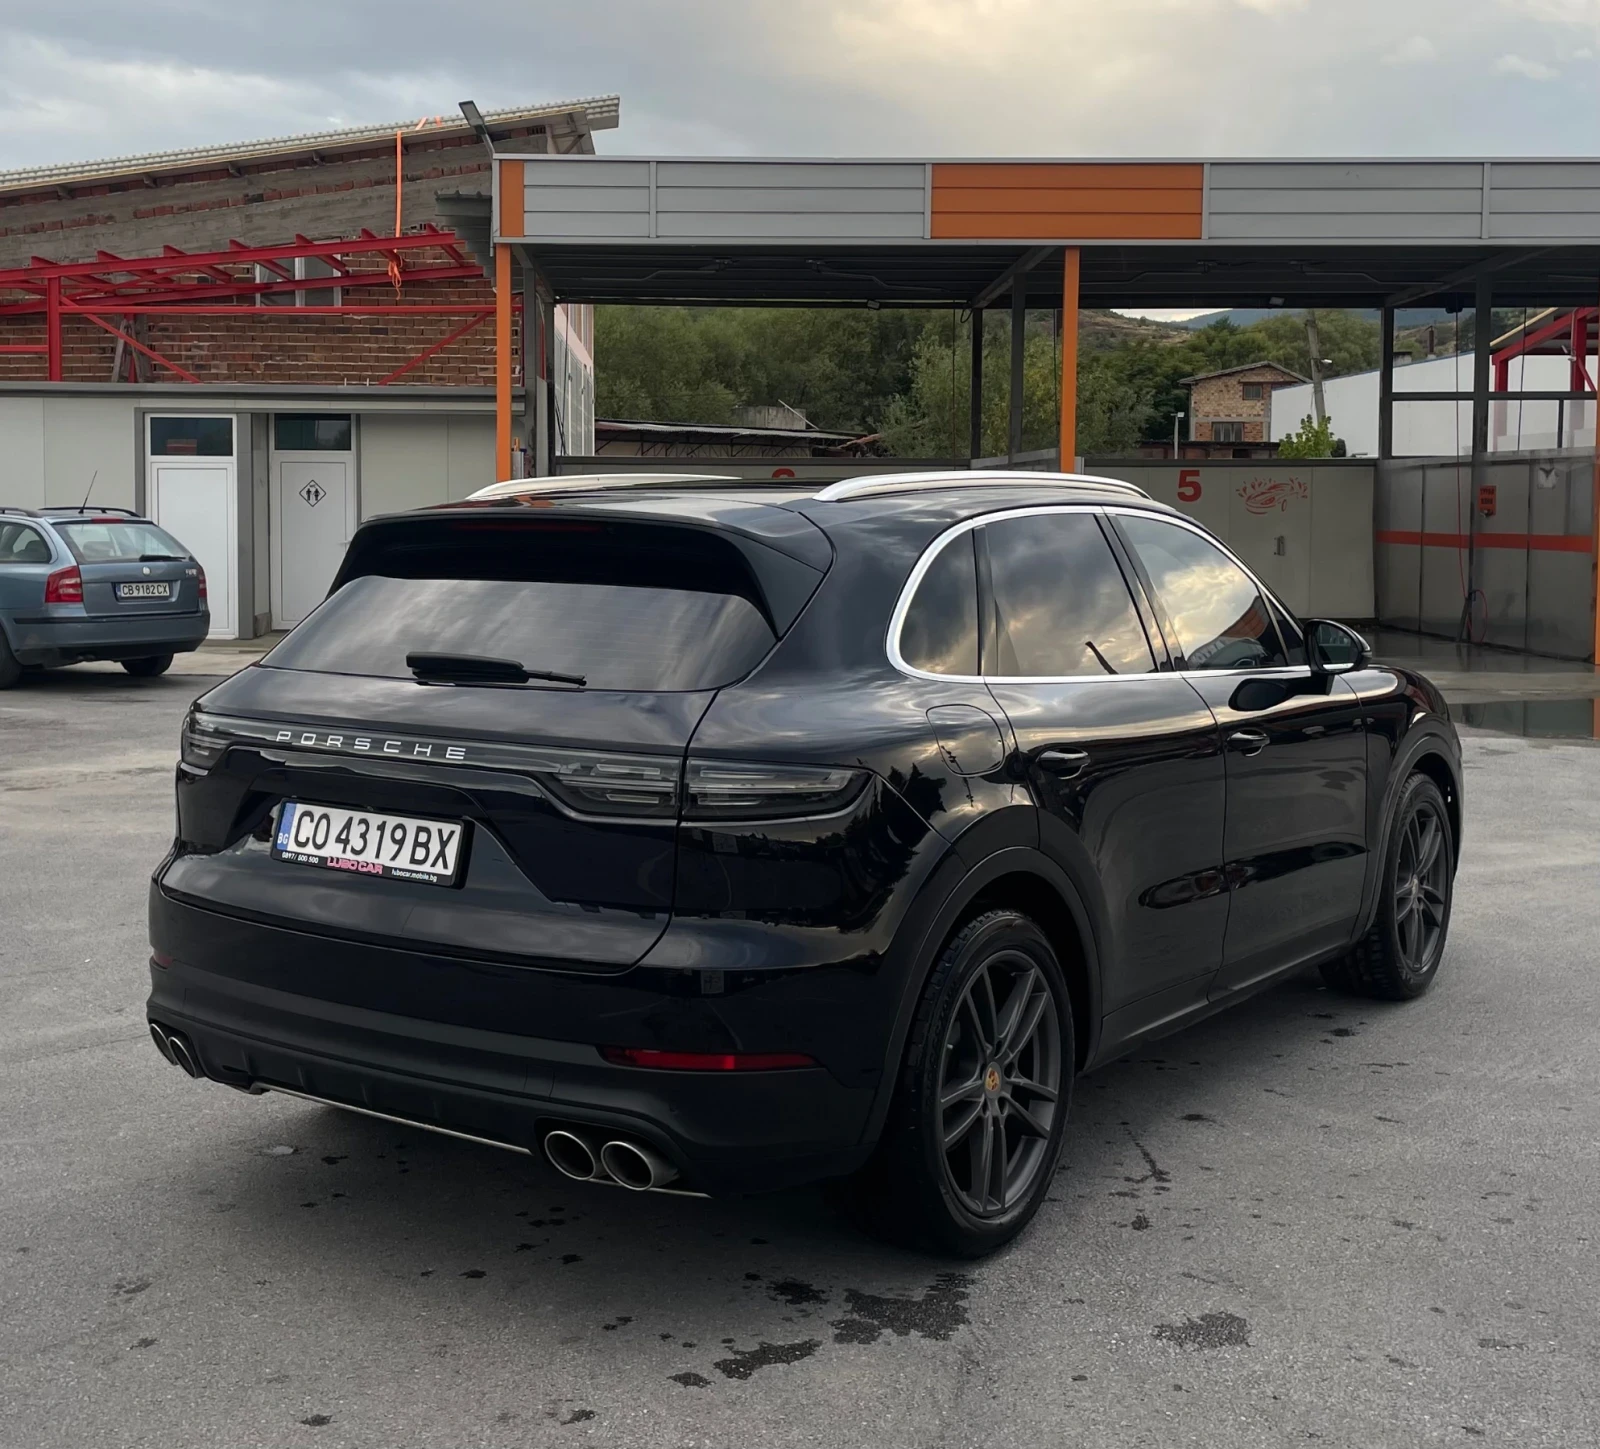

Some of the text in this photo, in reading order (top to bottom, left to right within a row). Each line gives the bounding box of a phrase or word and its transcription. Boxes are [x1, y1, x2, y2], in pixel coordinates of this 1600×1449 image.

[1177, 469, 1202, 502] 5
[122, 584, 168, 596] CB 9182 CX
[276, 730, 466, 760] PORSCHE
[277, 832, 289, 845] BG
[294, 810, 456, 870] CO 4319 BX
